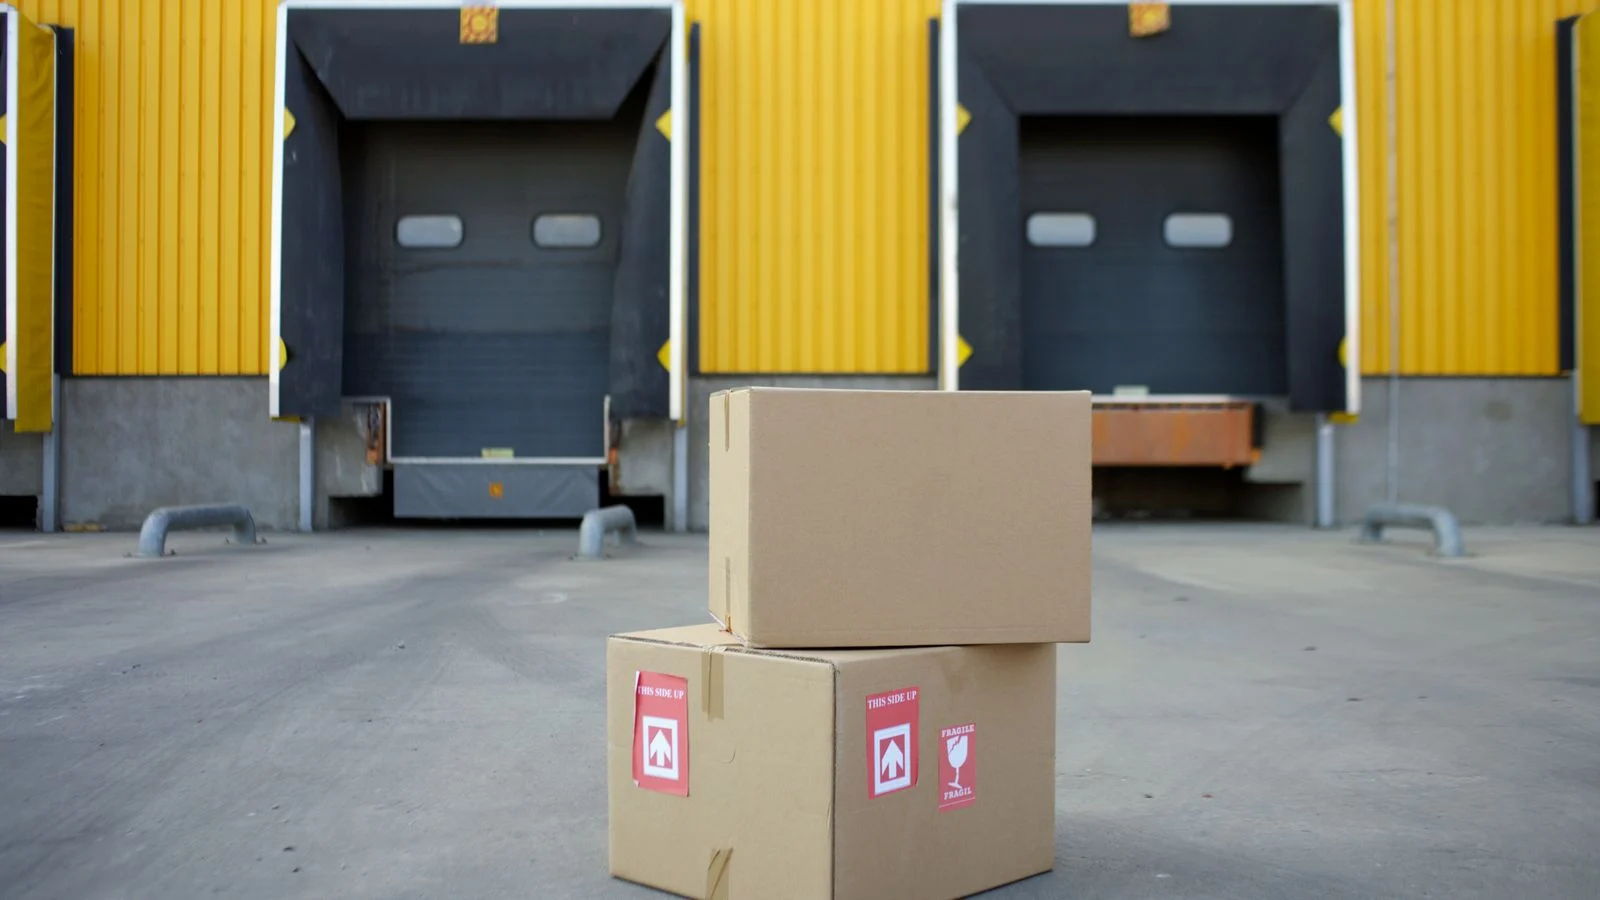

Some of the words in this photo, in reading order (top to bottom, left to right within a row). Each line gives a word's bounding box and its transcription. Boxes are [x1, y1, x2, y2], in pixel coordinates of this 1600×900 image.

[654, 687, 672, 698] SIDE
[673, 689, 684, 700] UP
[867, 697, 886, 709] THIS
[887, 692, 905, 705] SIDE
[906, 690, 917, 701] UP
[941, 724, 975, 738] FRAGILE
[943, 787, 972, 800] FRAGIL
